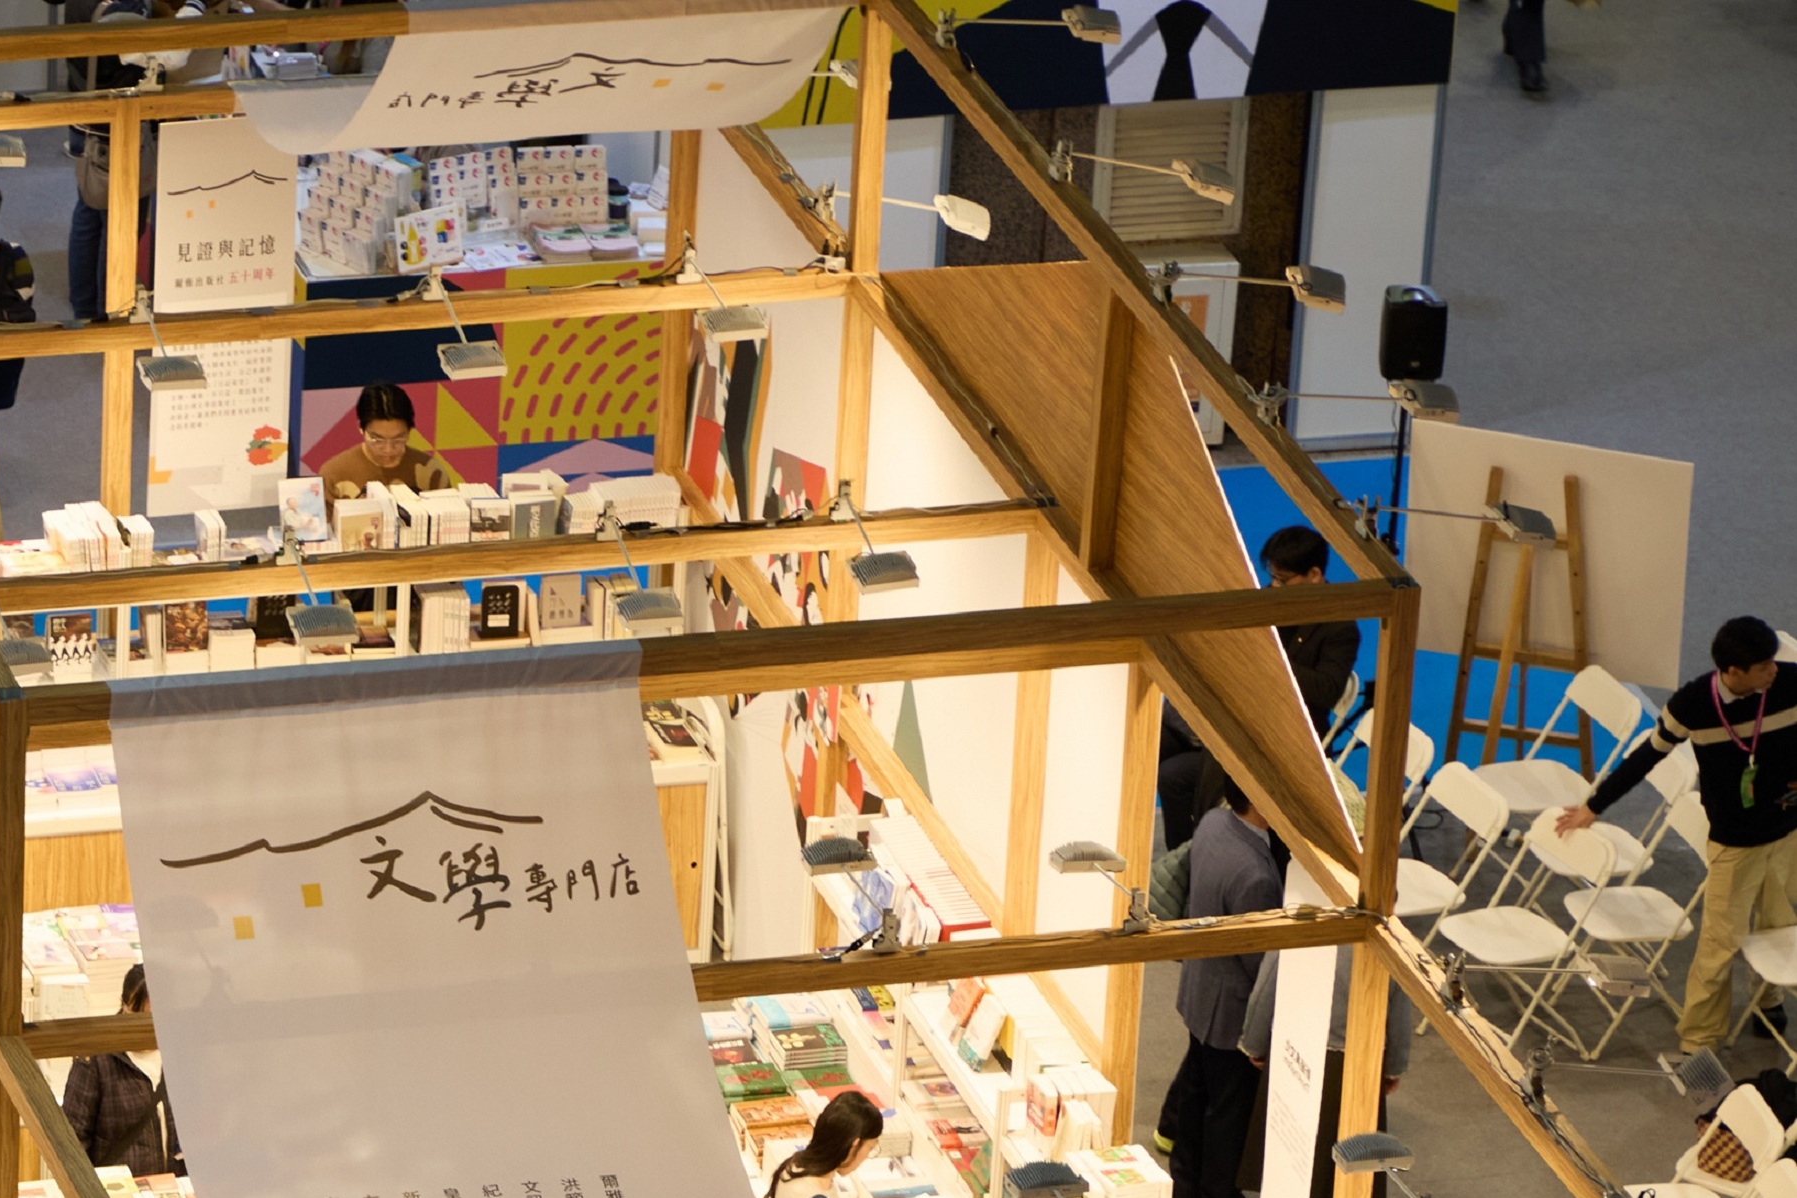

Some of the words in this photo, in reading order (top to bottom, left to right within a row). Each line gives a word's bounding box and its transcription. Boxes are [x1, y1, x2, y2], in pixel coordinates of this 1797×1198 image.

[178, 234, 275, 262] 見證與記憶
[359, 836, 640, 931] 文學專門店
